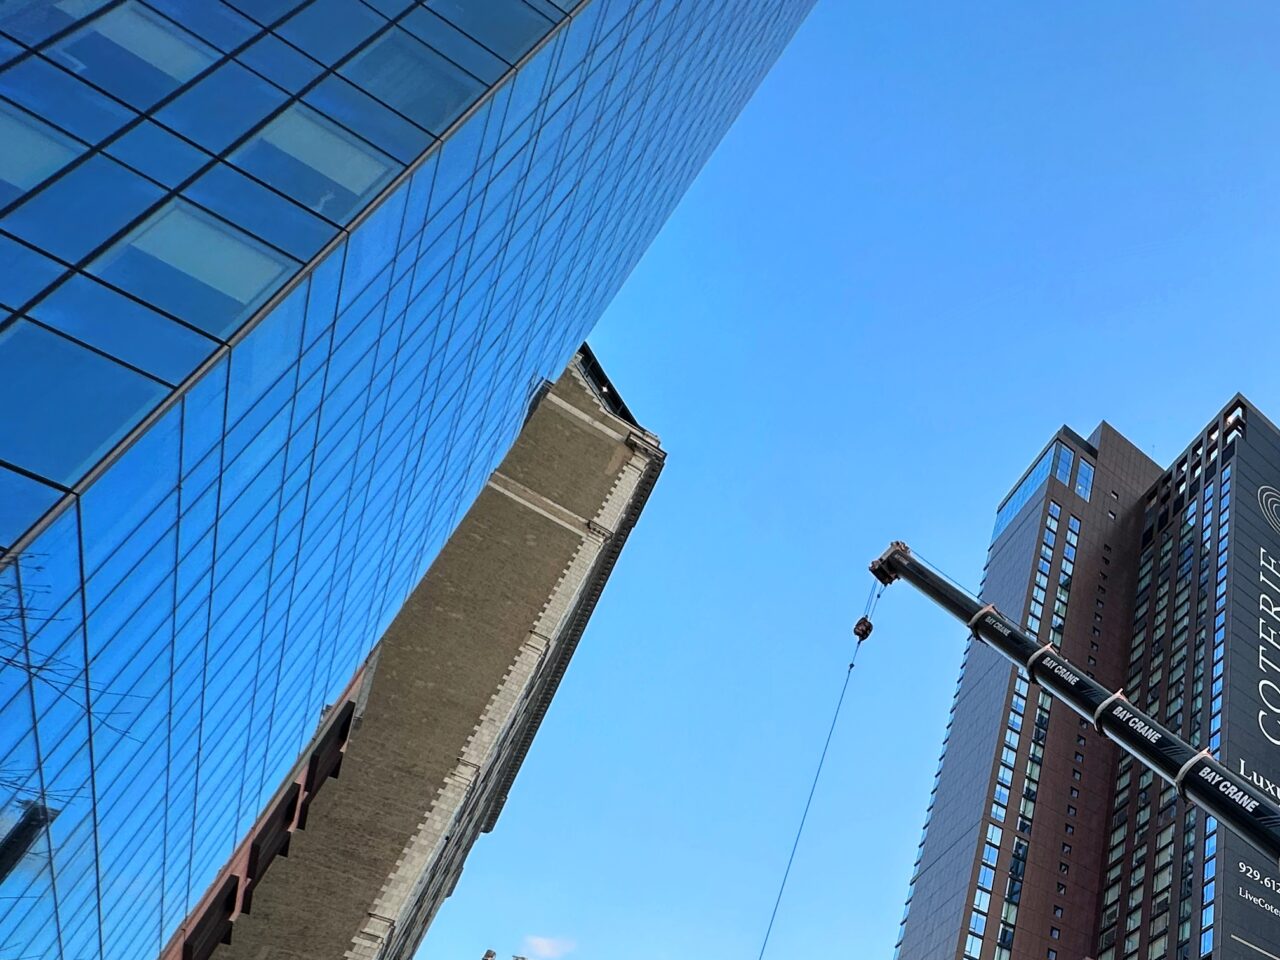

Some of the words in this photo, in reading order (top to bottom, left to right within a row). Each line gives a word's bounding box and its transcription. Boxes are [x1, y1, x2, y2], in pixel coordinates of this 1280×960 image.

[1041, 656, 1058, 671] BAY
[1054, 664, 1081, 687] CRANE
[1112, 705, 1132, 723] BAY
[1128, 716, 1163, 745] CRANE
[1198, 766, 1222, 786] BAY
[1218, 781, 1260, 813] CRANE
